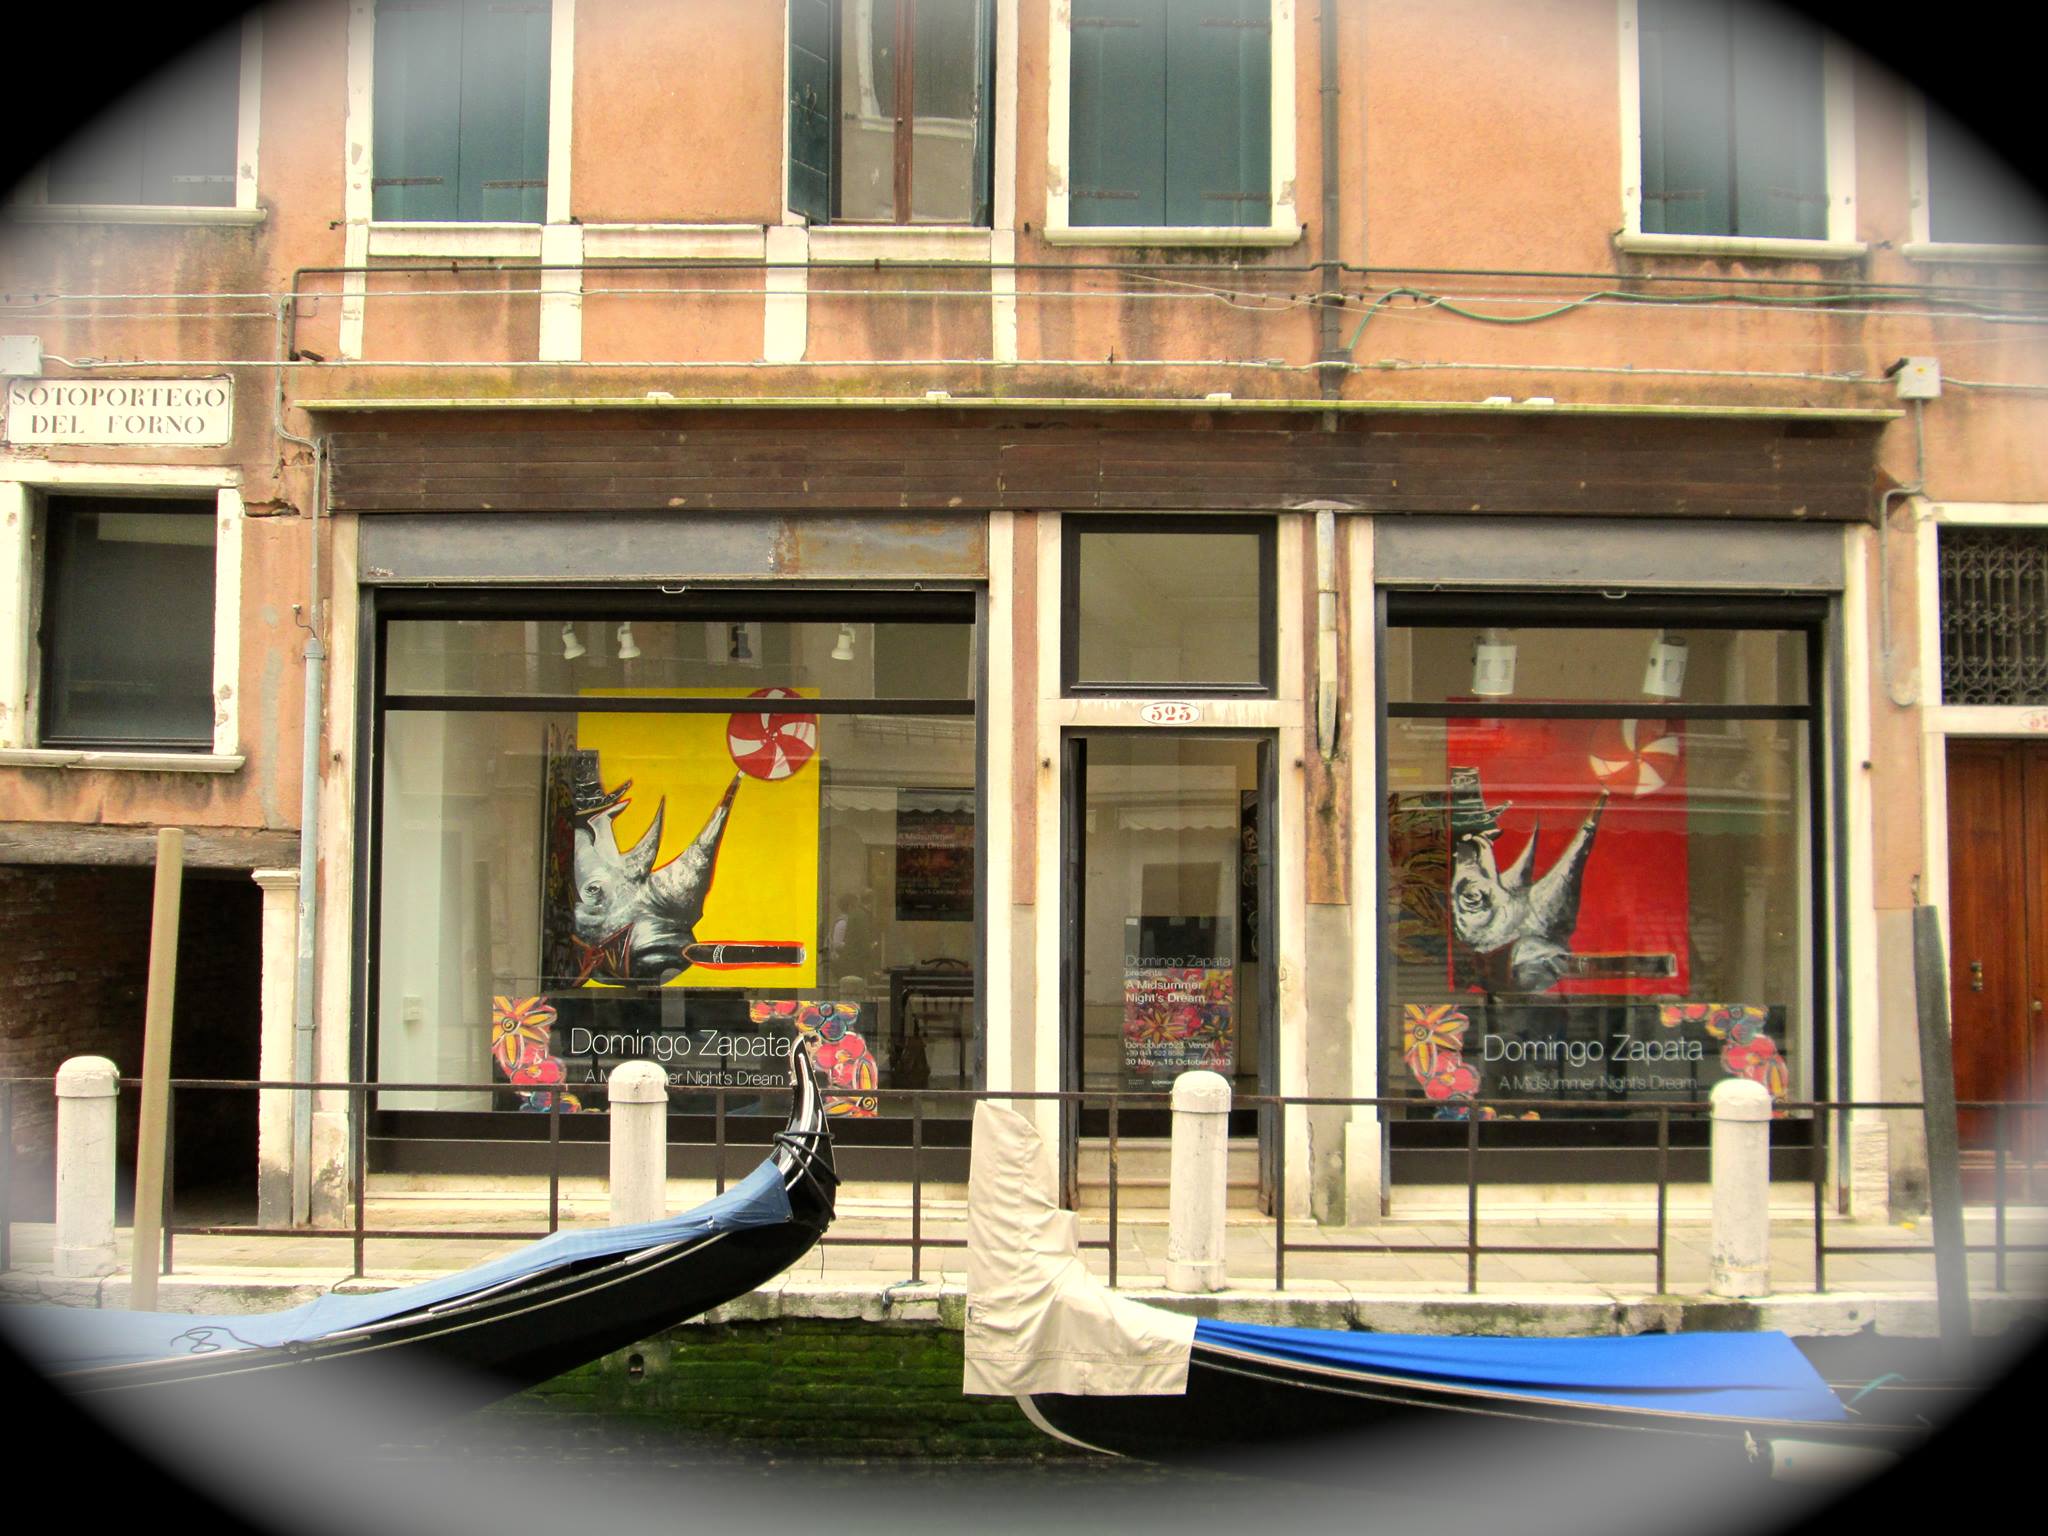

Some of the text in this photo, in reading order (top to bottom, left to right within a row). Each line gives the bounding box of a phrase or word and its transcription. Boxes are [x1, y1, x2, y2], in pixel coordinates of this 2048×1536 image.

[12, 387, 226, 407] SOTOPORTEGO
[32, 415, 205, 434] DEL FORNO
[1125, 954, 1231, 969] Domingo Zapata
[1125, 980, 1203, 990] A Midsummer
[1125, 993, 1205, 1005] Night's Dream
[571, 1027, 791, 1062] Domingo Zapata
[1483, 1034, 1704, 1068] Domingo Zapata
[1125, 1058, 1136, 1066] 30
[1137, 1058, 1155, 1067] May
[1175, 1058, 1209, 1066] October
[1210, 1058, 1231, 1066] 2013
[585, 1072, 596, 1083] A
[686, 1070, 733, 1087] Night's
[736, 1071, 784, 1086] Dream
[1499, 1076, 1697, 1092] A Midsummer Night's Dream
